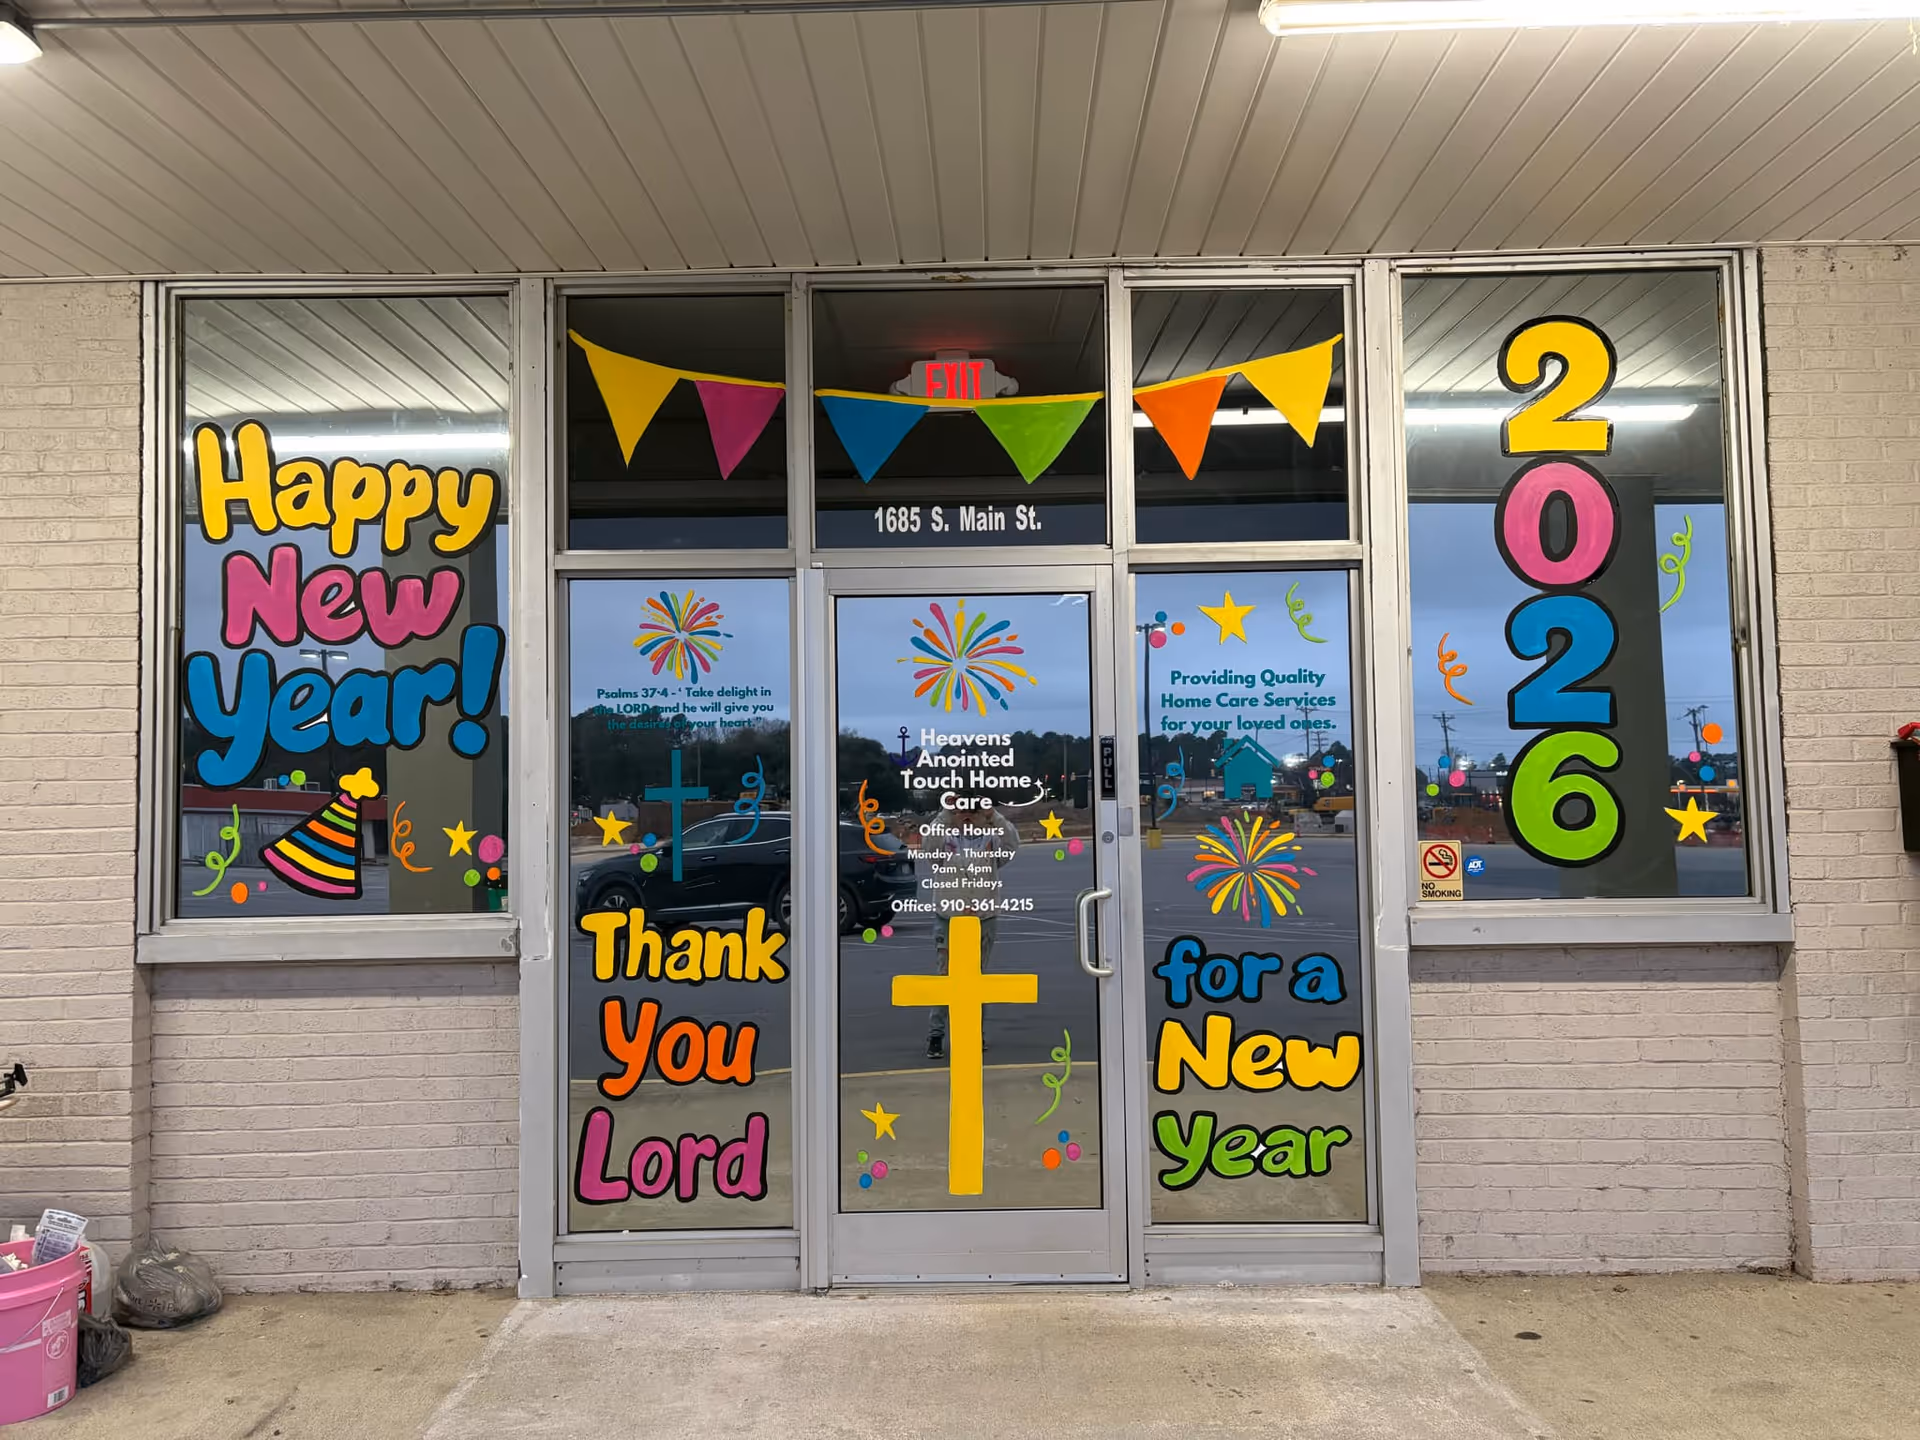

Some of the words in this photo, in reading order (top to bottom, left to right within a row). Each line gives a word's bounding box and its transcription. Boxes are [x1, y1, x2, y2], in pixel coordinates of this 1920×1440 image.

[925, 361, 984, 400] EXIT
[193, 419, 500, 556] Happy
[874, 506, 921, 533] 1685
[931, 506, 949, 532] S.
[960, 505, 1005, 531] Main
[1015, 504, 1042, 531] St.
[221, 543, 464, 649] New
[1494, 314, 1626, 868] 2026
[1171, 669, 1255, 688] Providing
[1260, 668, 1326, 687] Quality
[597, 687, 638, 699] Psalms
[685, 686, 714, 698] Take
[717, 685, 758, 699] delight
[760, 686, 772, 697] in
[1161, 693, 1211, 708] Home
[1216, 692, 1259, 707] Care
[1263, 692, 1336, 707] Services
[593, 704, 614, 715] the
[658, 702, 679, 713] and
[682, 702, 697, 713] he
[700, 701, 722, 712] will
[724, 702, 749, 715] give
[752, 704, 774, 714] you
[607, 718, 626, 730] the
[674, 716, 688, 728] of
[689, 720, 716, 731] your
[1160, 715, 1187, 731] for
[1191, 719, 1232, 734] your
[1237, 714, 1285, 730] loved
[1289, 717, 1337, 730] ones.
[920, 728, 1011, 746] Heavens
[916, 749, 1014, 768] Anointed
[1103, 747, 1113, 789] PULL
[900, 768, 964, 790] Touch
[970, 770, 1032, 789] Home
[940, 792, 993, 810] Care
[919, 824, 960, 837] Office
[963, 824, 1004, 837] Hours
[907, 849, 953, 861] Monday
[963, 848, 1015, 861] Thursday
[931, 864, 957, 874] 9am
[967, 864, 992, 876] 4pm
[1468, 860, 1483, 869] ADT
[921, 878, 959, 889] Closed
[961, 878, 1003, 890] Fridays
[1421, 882, 1436, 890] NO
[1421, 889, 1461, 898] SMOKING
[891, 899, 937, 913] Office:
[940, 899, 1034, 912] 910-361-4215
[576, 906, 790, 986] Thank
[1153, 935, 1284, 1009] for
[1289, 952, 1347, 1005] a
[1153, 1011, 1364, 1095] New
[574, 1106, 770, 1205] Lord
